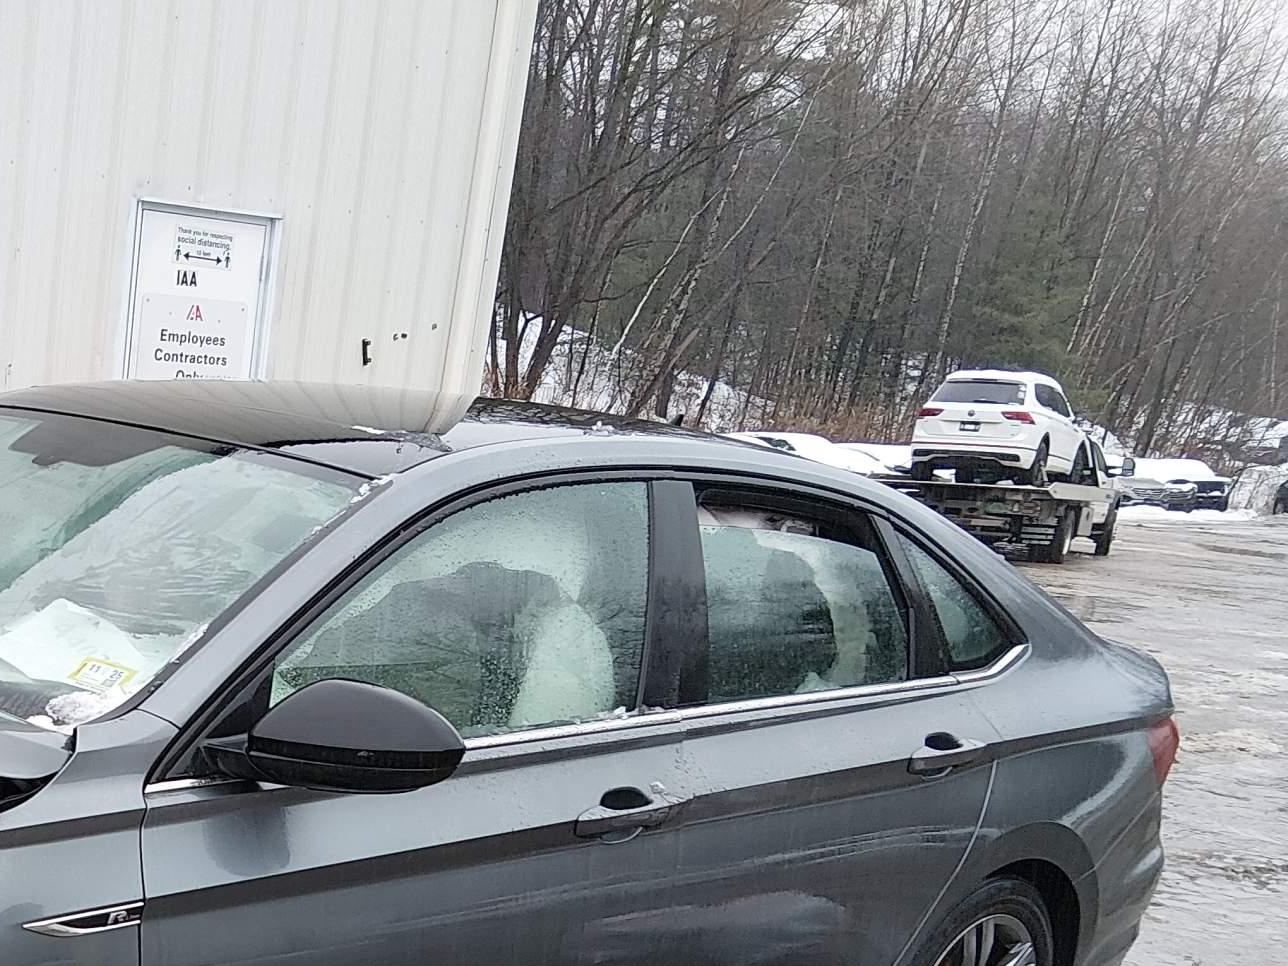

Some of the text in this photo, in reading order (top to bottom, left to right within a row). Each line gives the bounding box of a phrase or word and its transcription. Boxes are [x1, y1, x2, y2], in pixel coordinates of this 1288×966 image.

[176, 270, 198, 287] IAA
[160, 328, 226, 348] Employees
[154, 348, 227, 366] Contractors
